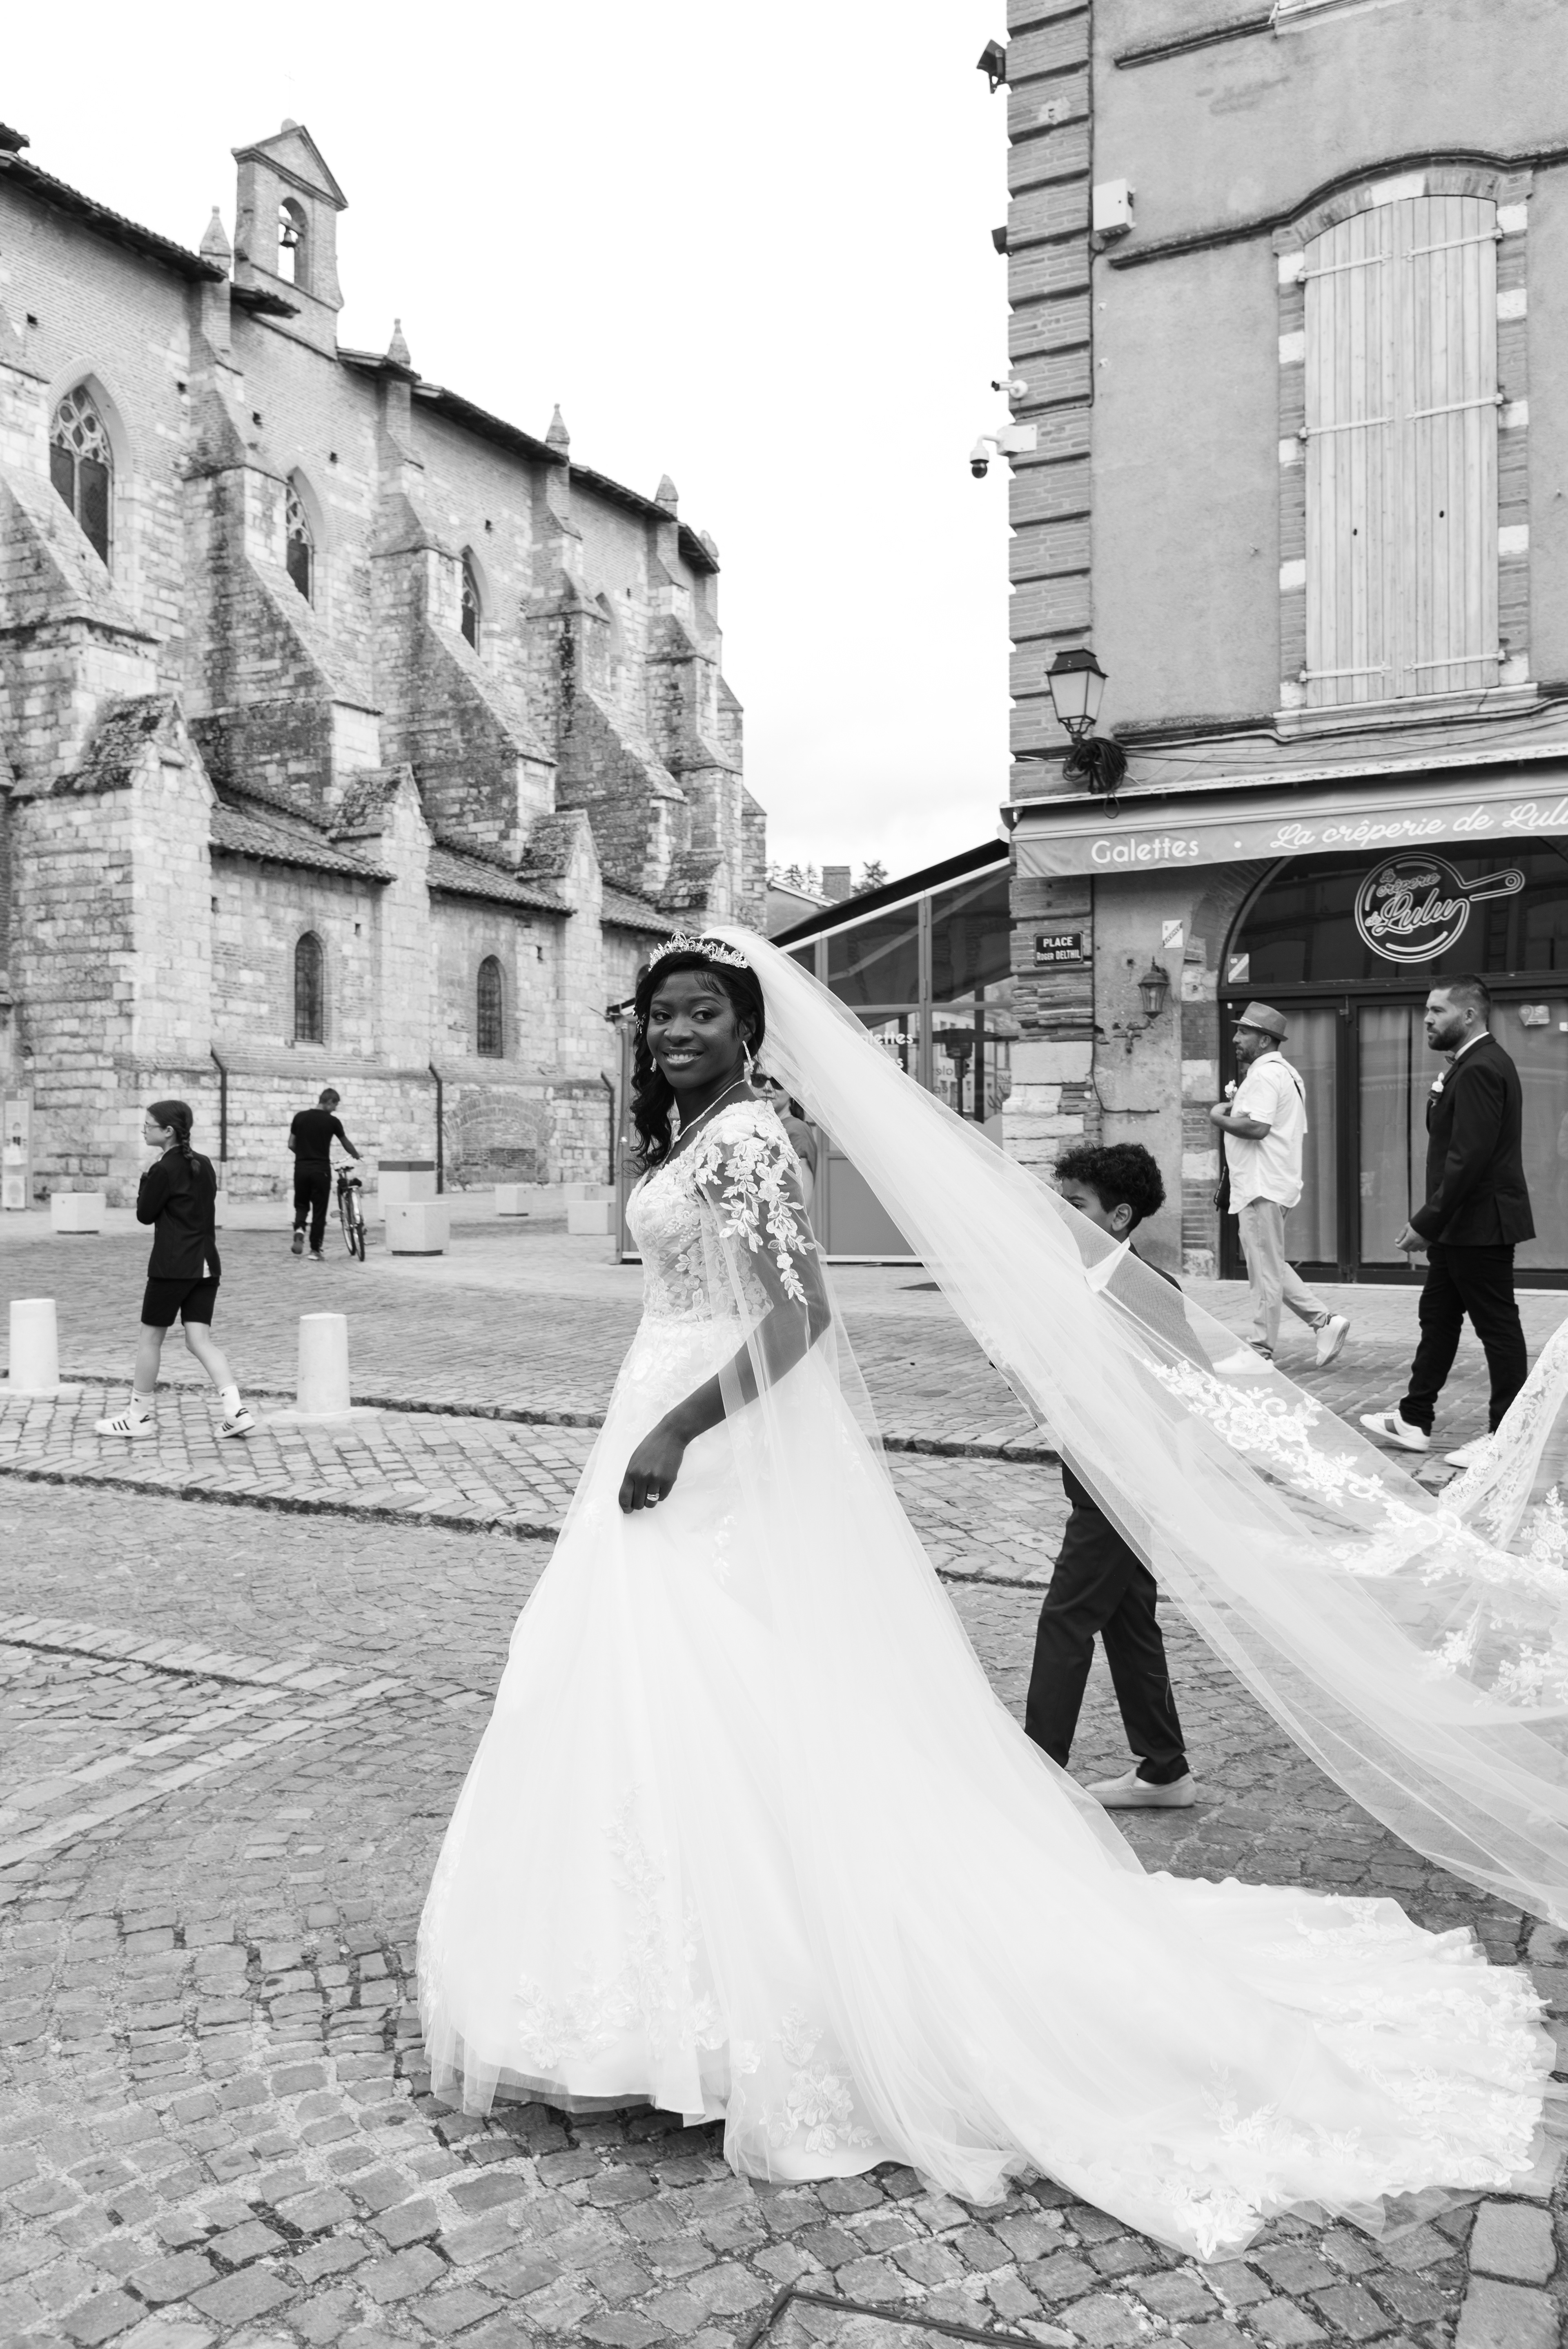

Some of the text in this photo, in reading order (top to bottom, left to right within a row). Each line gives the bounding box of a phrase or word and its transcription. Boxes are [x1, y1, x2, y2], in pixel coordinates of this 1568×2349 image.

[1091, 838, 1199, 864] Galettes
[1270, 823, 1316, 849] La
[1321, 818, 1447, 848] crêperie
[1452, 805, 1494, 831] de
[1371, 887, 1459, 936] Lulu
[1043, 936, 1074, 948] PLACE
[1055, 949, 1081, 960] DELTHIL
